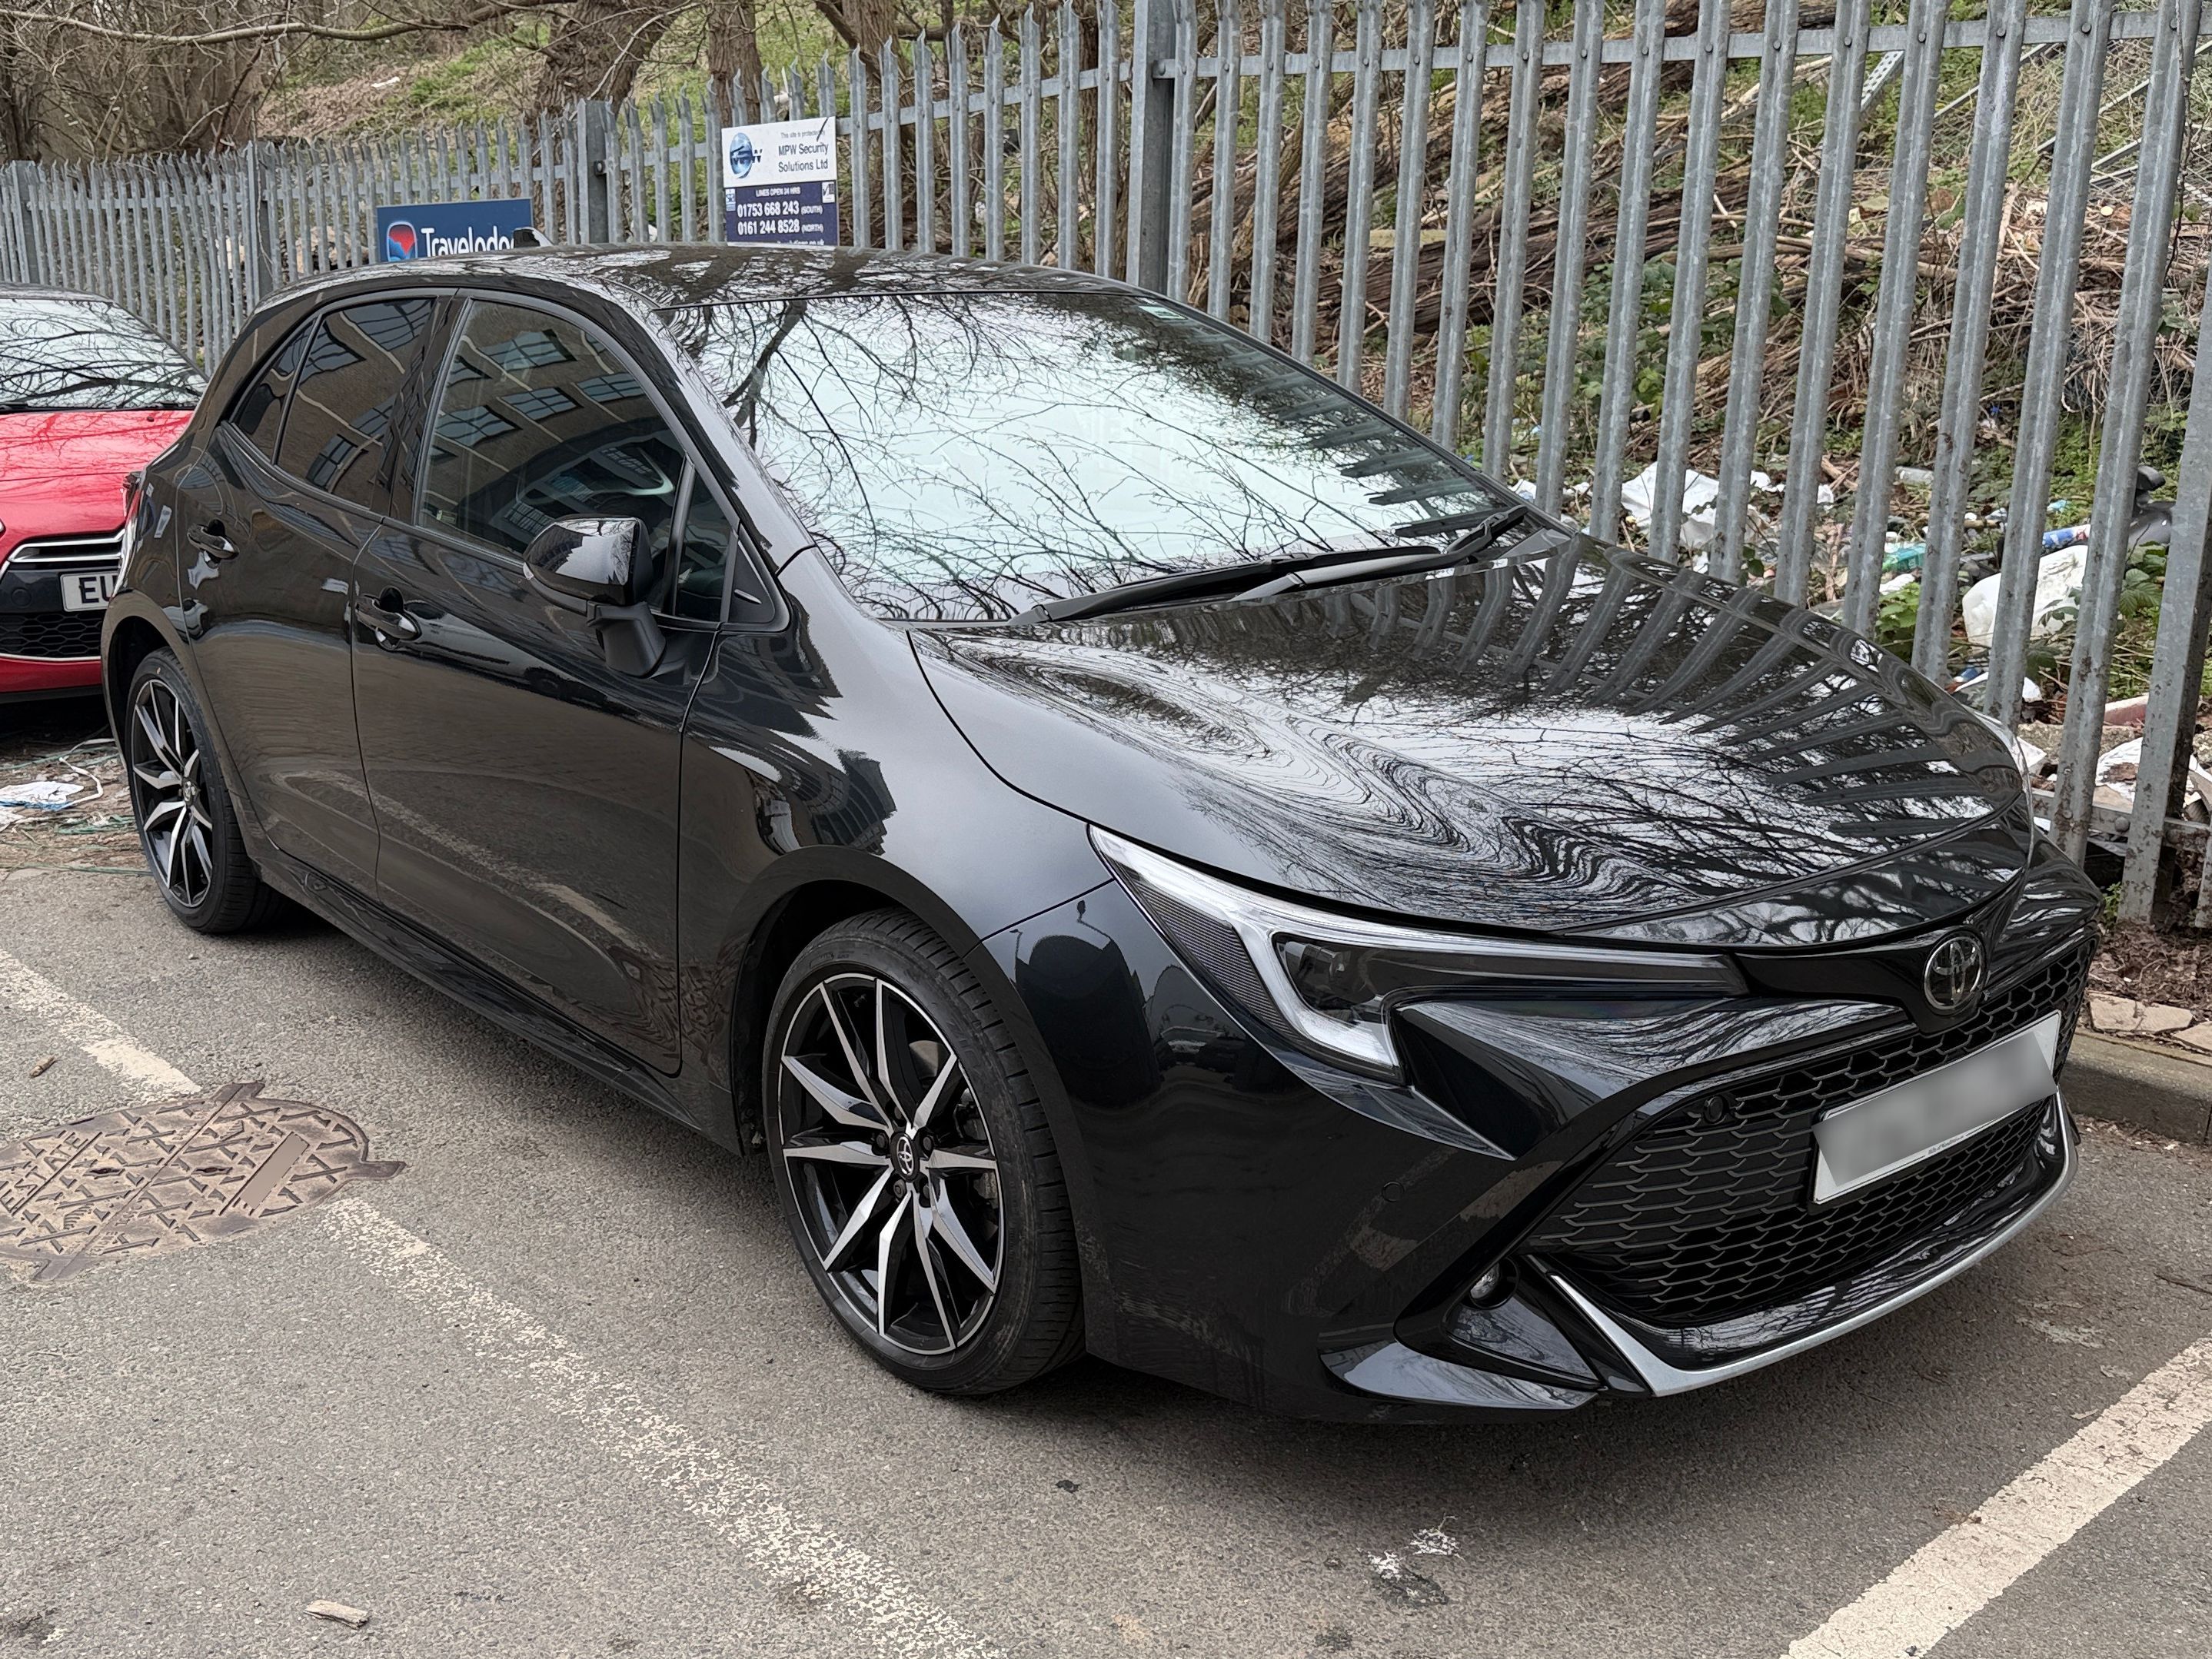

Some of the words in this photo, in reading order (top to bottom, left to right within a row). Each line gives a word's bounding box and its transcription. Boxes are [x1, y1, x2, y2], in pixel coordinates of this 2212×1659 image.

[778, 144, 797, 156] MPW
[799, 142, 829, 155] Security
[778, 161, 813, 173] Solutions
[816, 158, 828, 170] Ltd
[770, 188, 783, 196] OPEN
[790, 186, 801, 194] HRS
[737, 202, 763, 218] 01753
[782, 200, 800, 215] 243
[737, 221, 757, 235] 0161
[759, 220, 777, 234] 244
[777, 218, 800, 234] 8528
[0, 1132, 88, 1214] ESTATE
